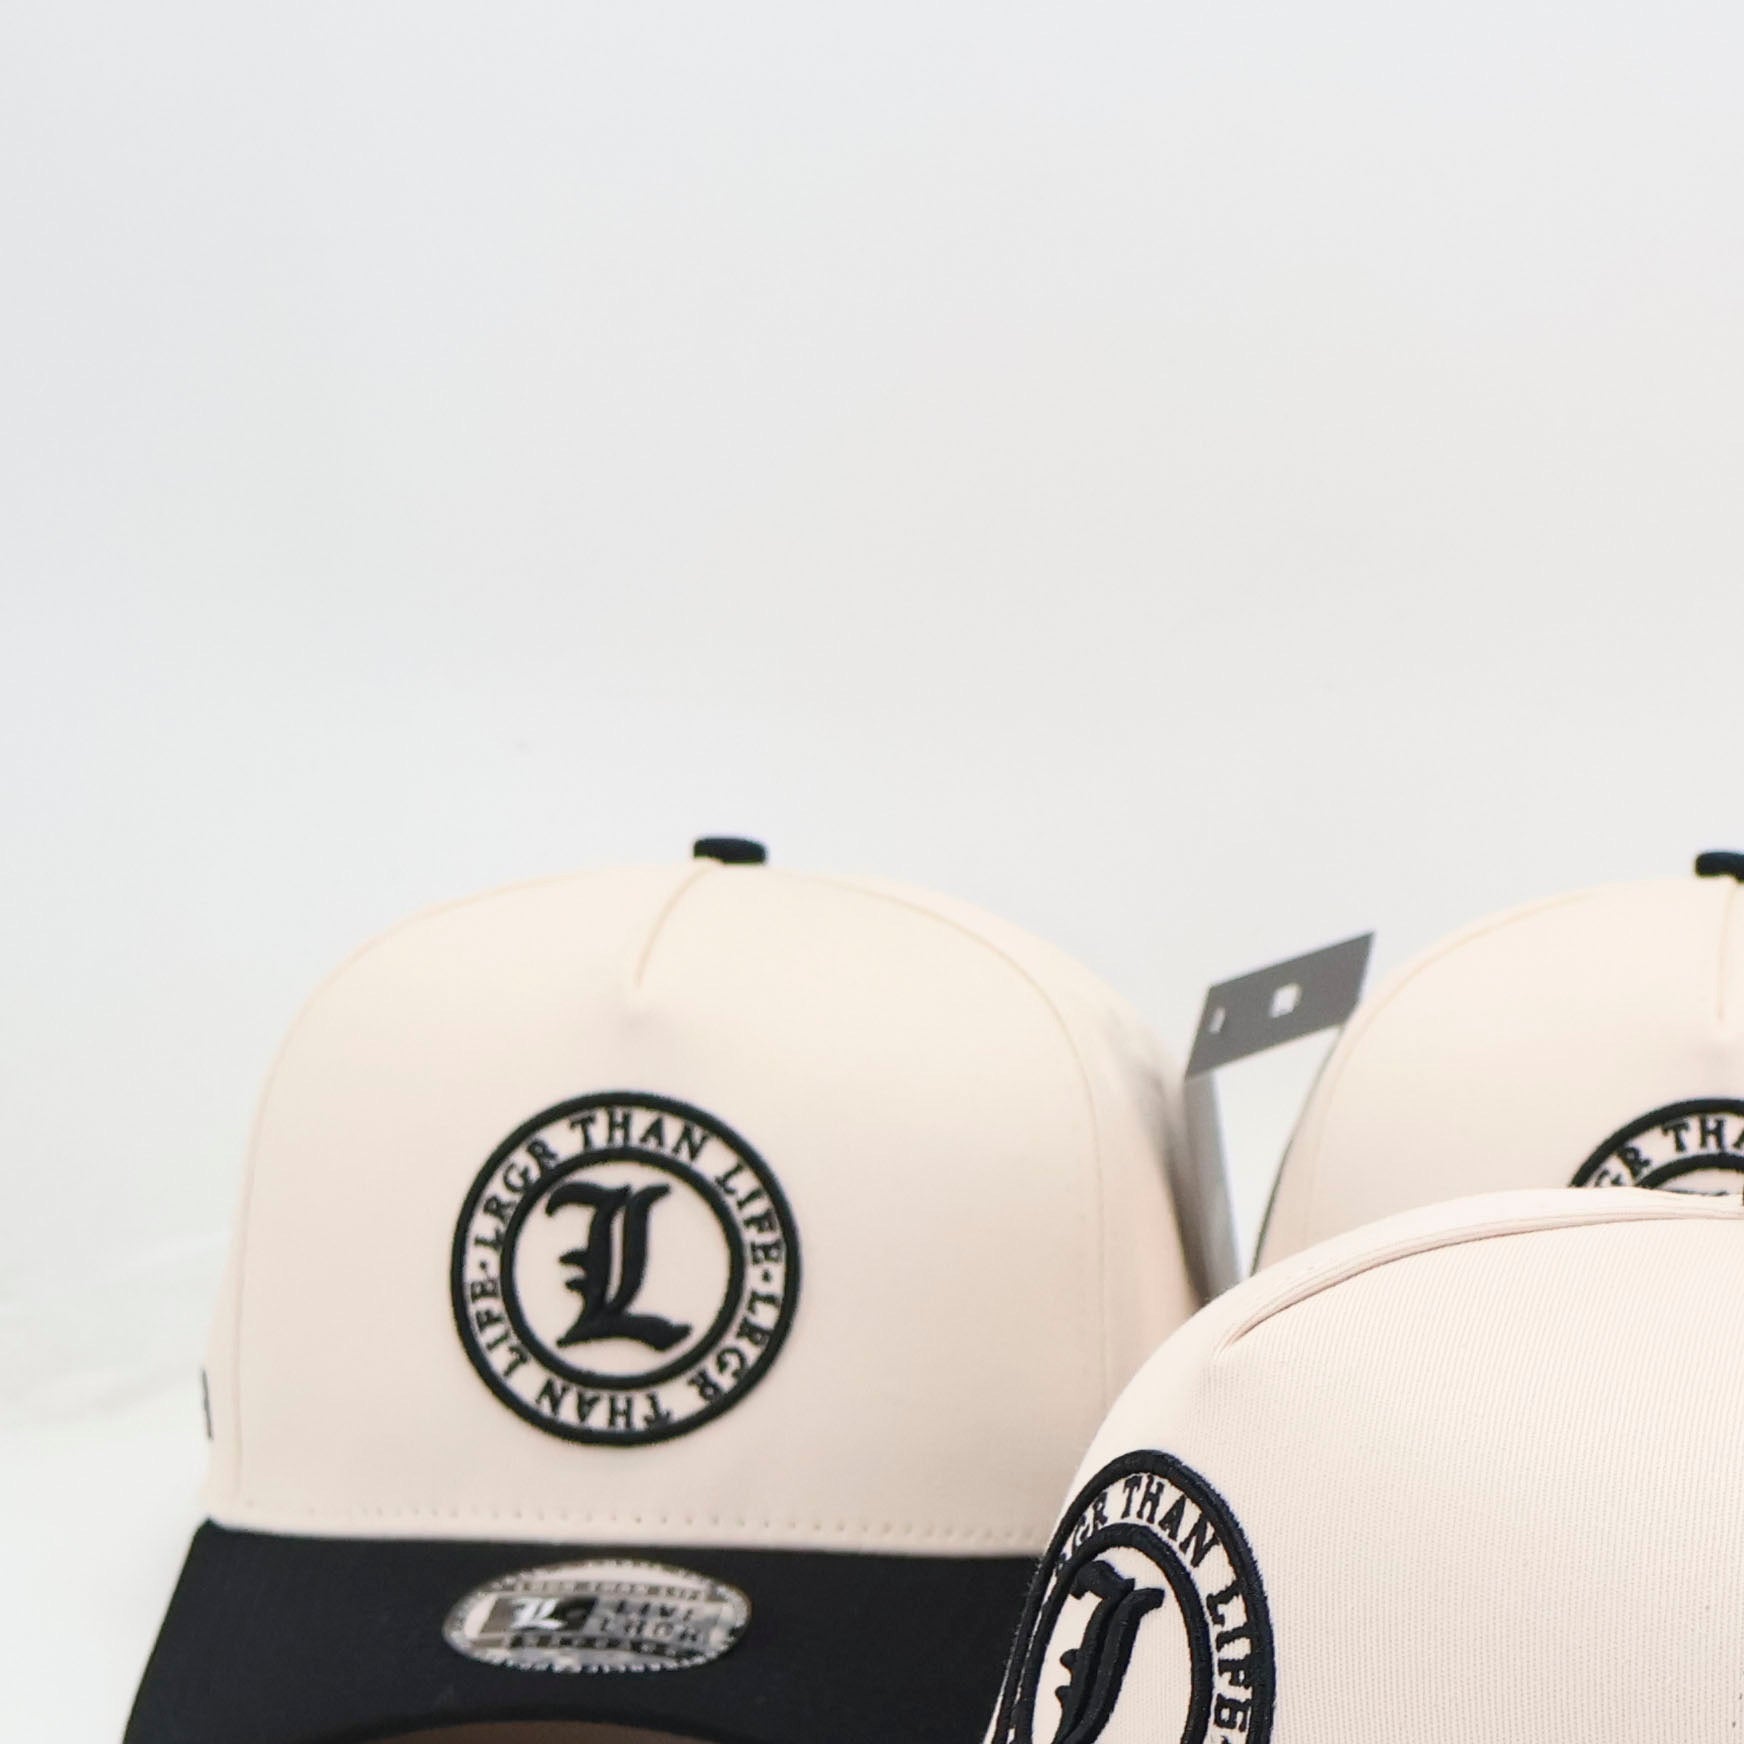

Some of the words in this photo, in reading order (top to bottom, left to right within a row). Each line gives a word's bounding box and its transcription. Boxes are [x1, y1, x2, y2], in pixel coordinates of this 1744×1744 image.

[475, 1138, 556, 1250] LRGR
[570, 1107, 709, 1162] THAN
[715, 1163, 782, 1265] LIFE
[470, 1279, 530, 1378] LIFE
[545, 1181, 692, 1352] L
[537, 1377, 672, 1430] THAN
[687, 1289, 780, 1402] LRGR
[1121, 1474, 1221, 1568] THAN
[1206, 1579, 1253, 1732] LIFE
